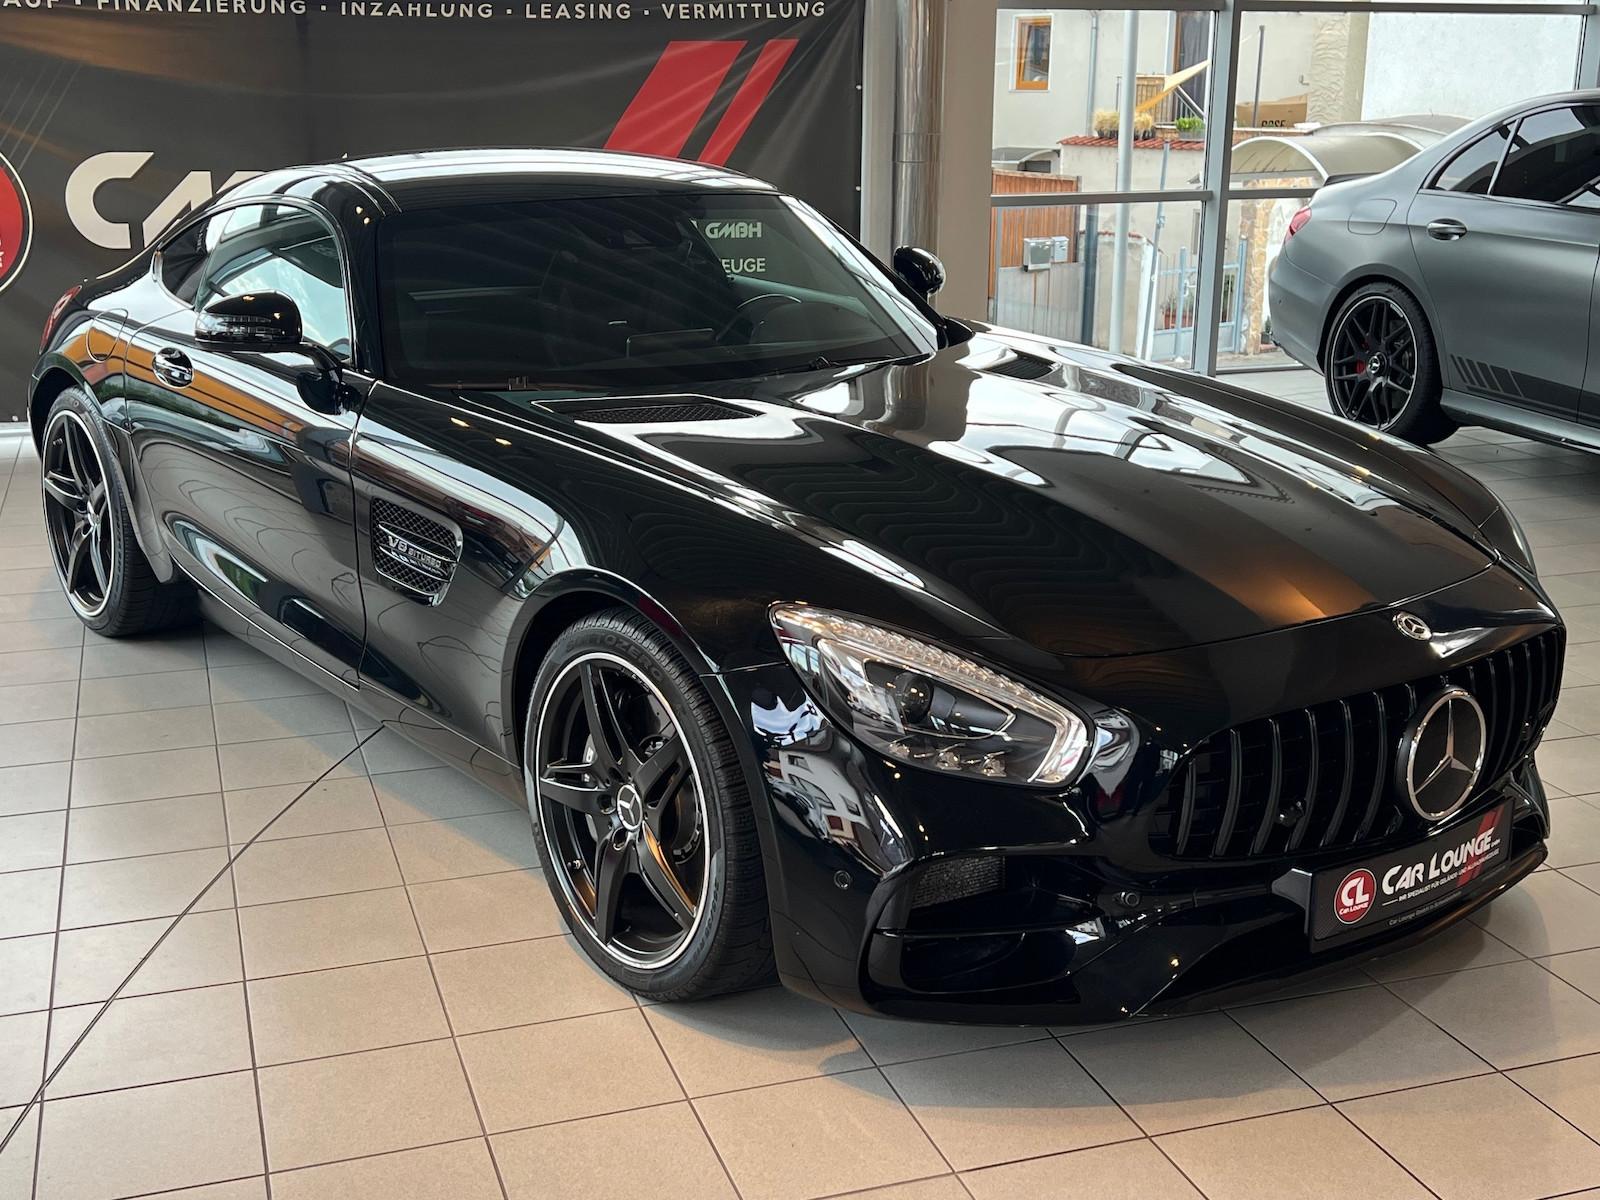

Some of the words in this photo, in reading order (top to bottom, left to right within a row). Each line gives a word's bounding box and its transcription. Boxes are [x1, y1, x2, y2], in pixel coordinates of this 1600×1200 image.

[97, 0, 306, 15] FINANZIERUNG
[341, 1, 493, 19] INZAHLUNG
[525, 3, 631, 20] LEASING
[661, 1, 825, 20] VERMITTLUNG
[388, 535, 408, 552] V8
[1382, 862, 1425, 896] CAR
[1428, 826, 1495, 881] LOUNGE
[1340, 876, 1370, 907] CL
